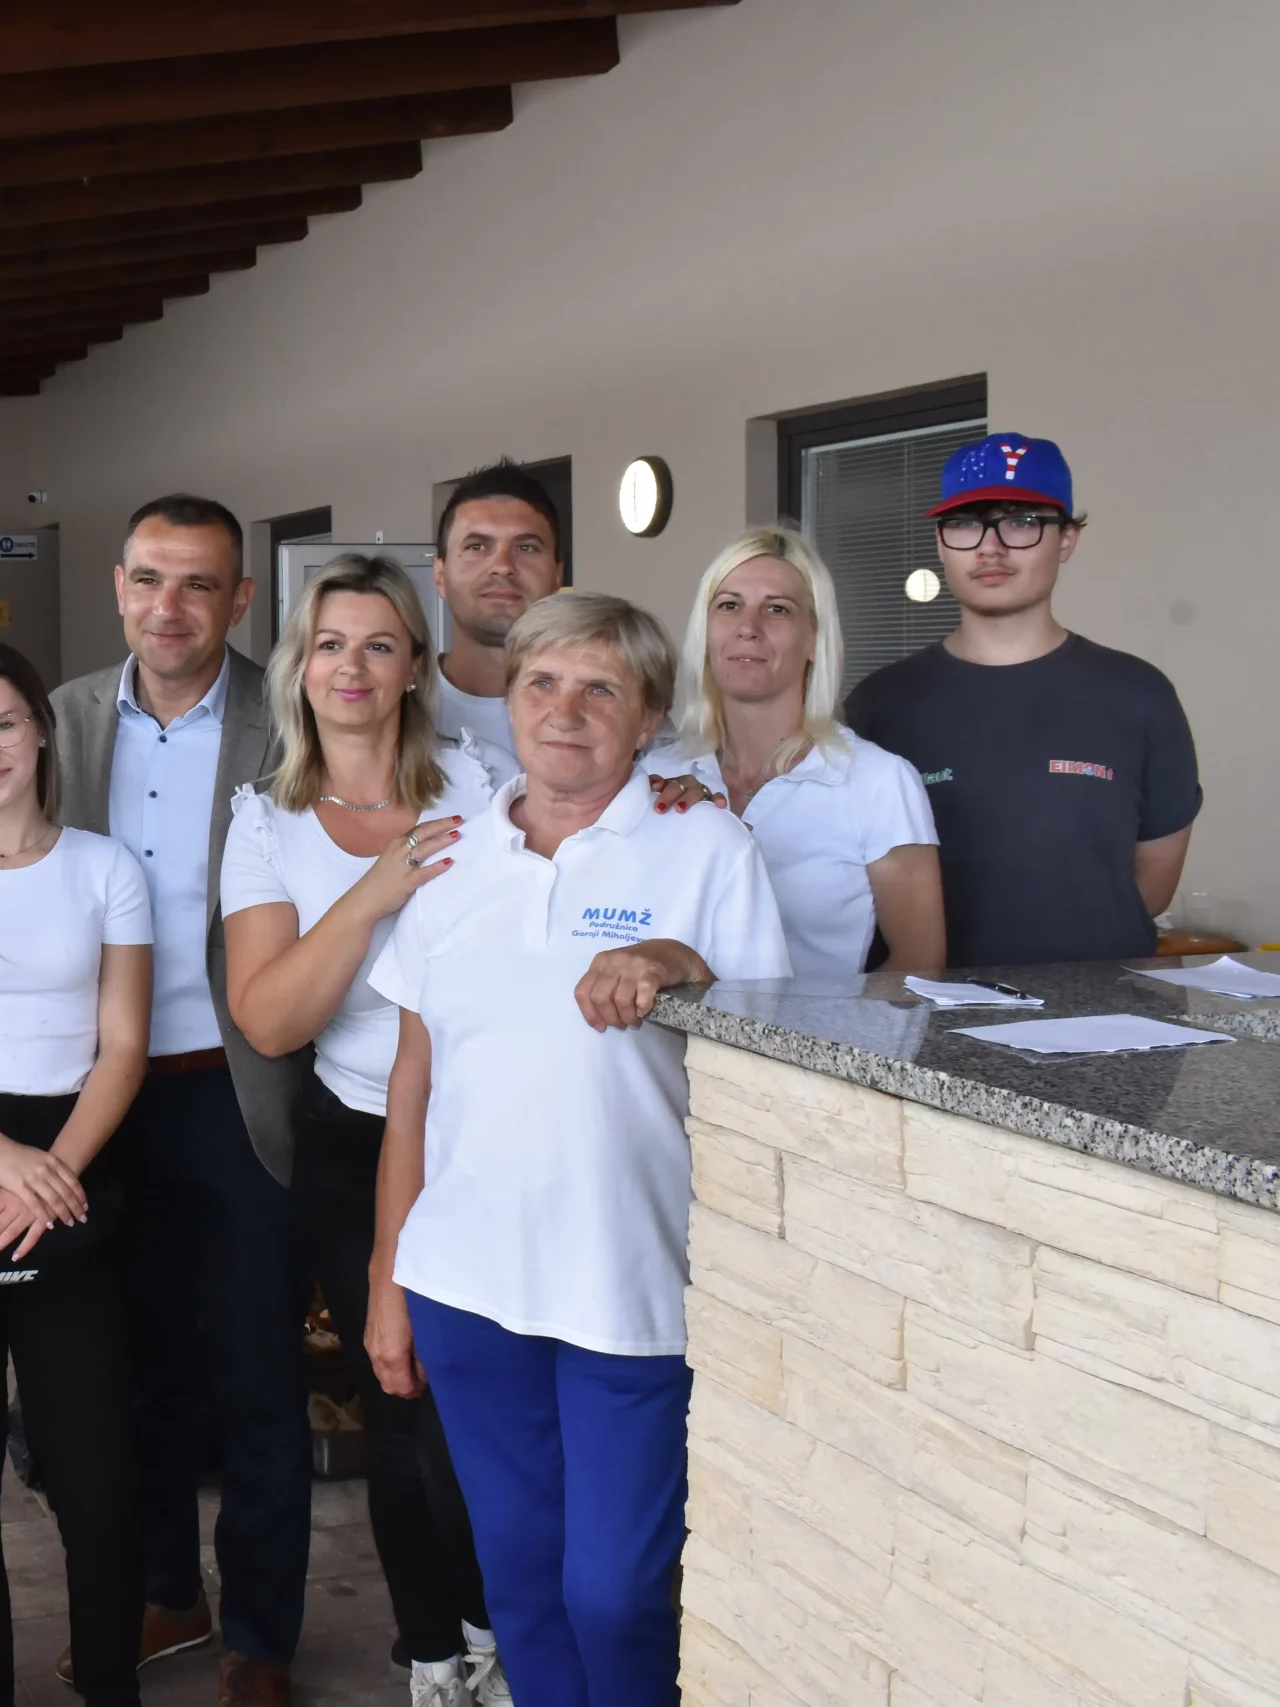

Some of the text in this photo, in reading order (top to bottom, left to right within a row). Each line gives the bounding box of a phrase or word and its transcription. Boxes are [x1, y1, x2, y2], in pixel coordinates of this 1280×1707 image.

[582, 908, 652, 925] MUMŽ
[589, 921, 638, 932] Podružnica
[572, 930, 646, 943] Gornji Mihaljev
